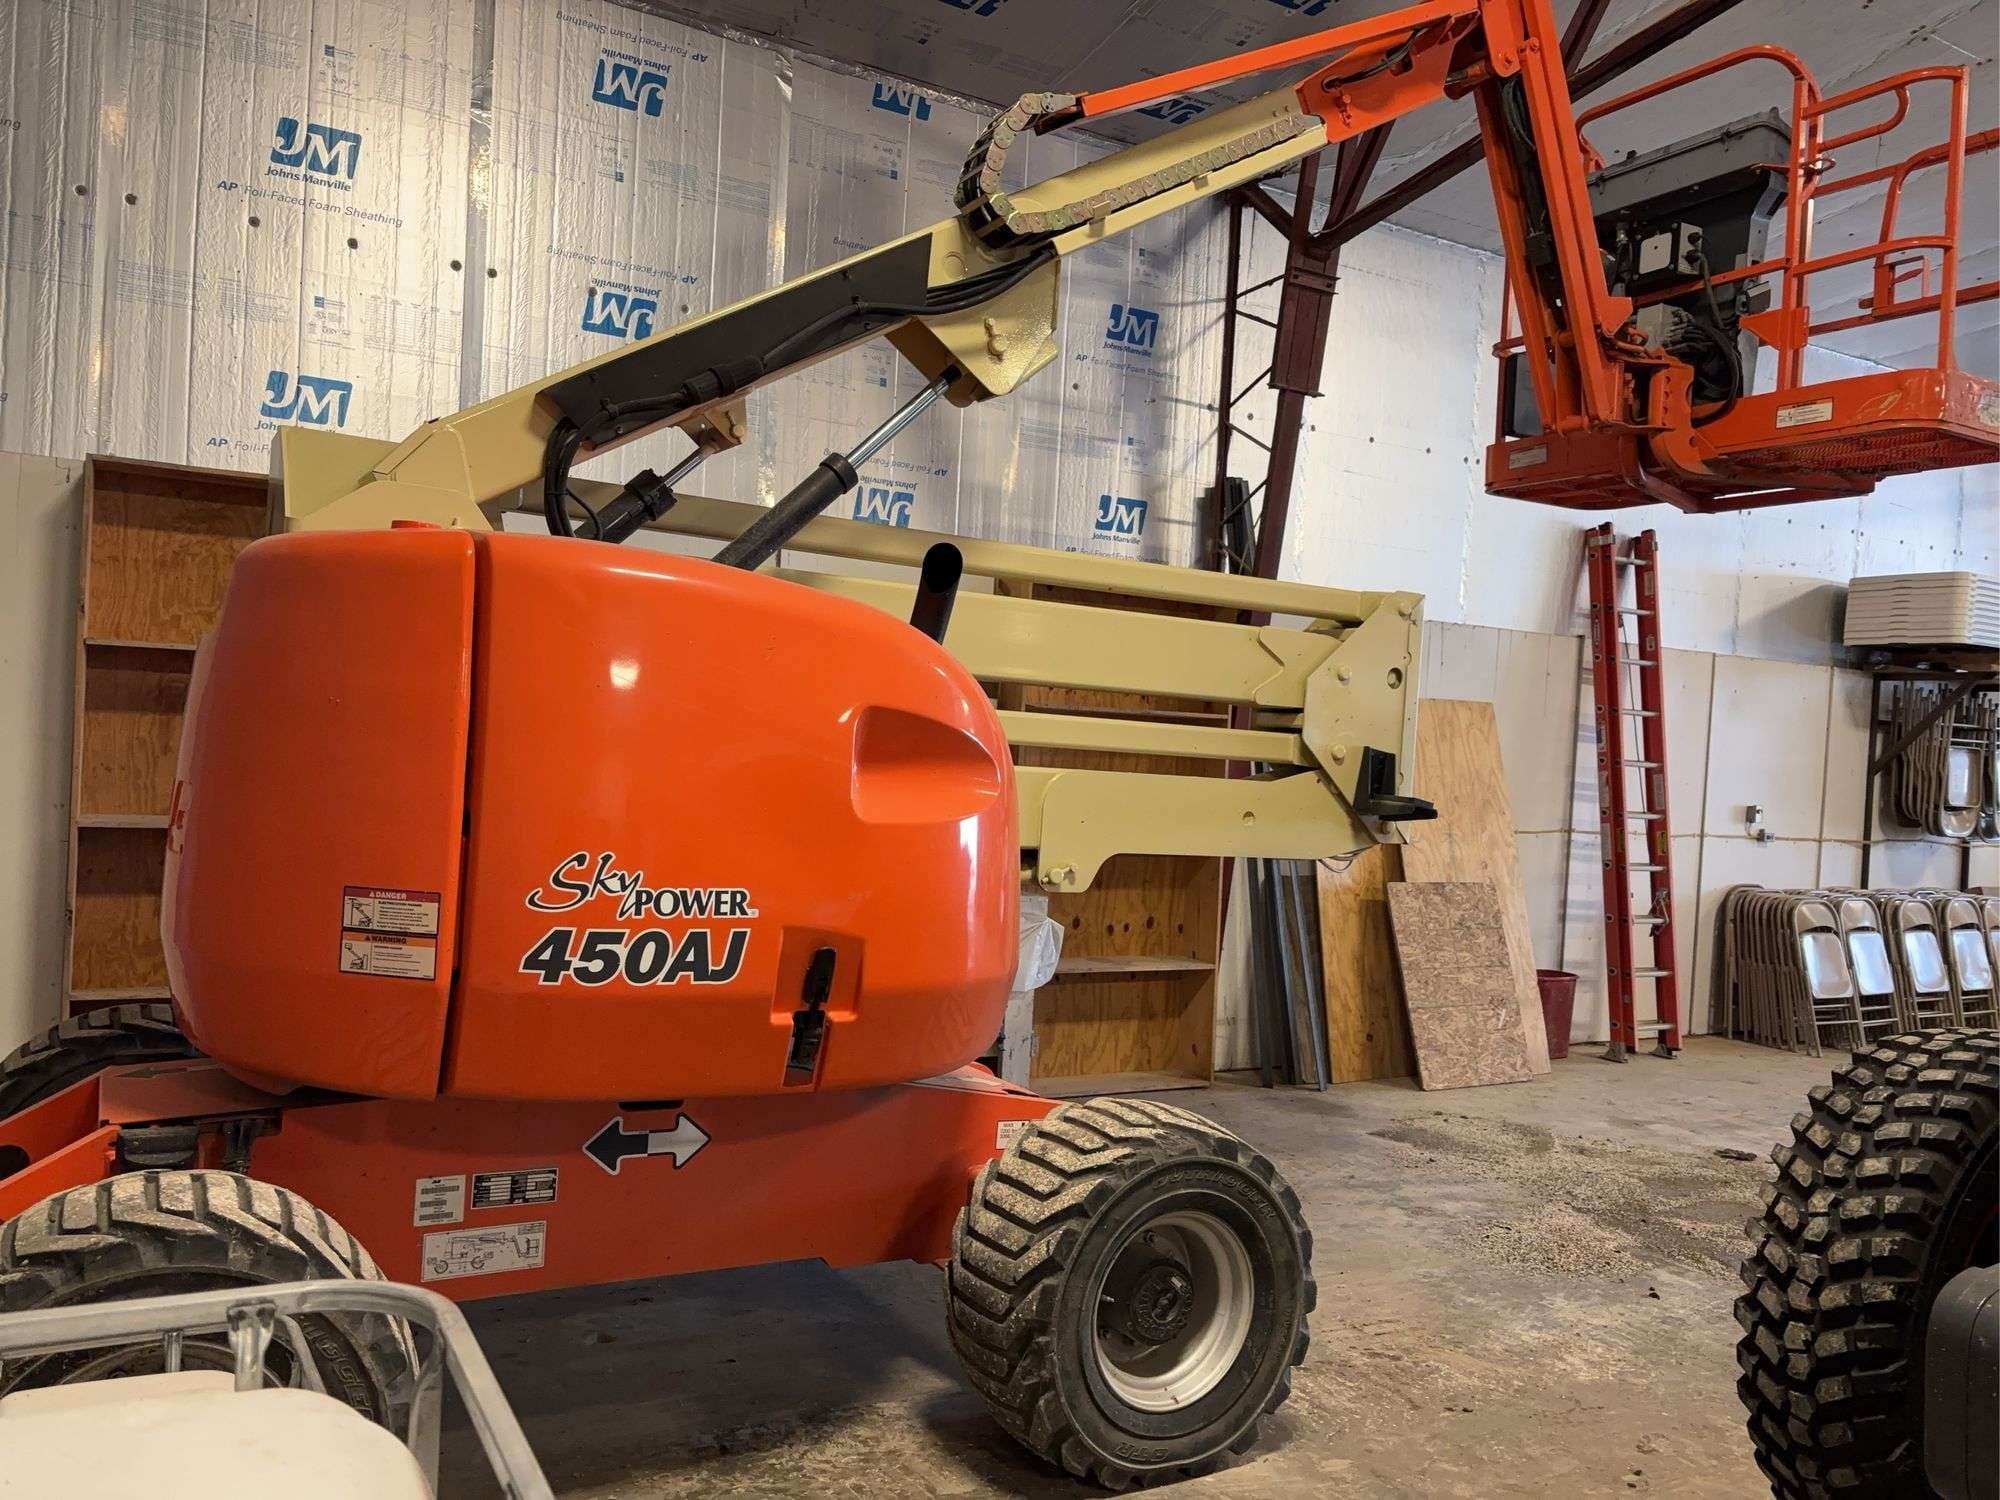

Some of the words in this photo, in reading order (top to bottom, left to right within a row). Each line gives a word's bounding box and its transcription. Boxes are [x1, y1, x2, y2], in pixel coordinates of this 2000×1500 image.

[609, 28, 638, 43] Foam
[601, 48, 644, 66] Manville
[643, 60, 672, 74] Johns
[591, 58, 668, 118] JM
[270, 116, 363, 180] JM
[264, 165, 301, 182] Johns
[301, 173, 352, 192] Manville
[217, 180, 239, 191] AP
[244, 185, 305, 206] Foil-Faced
[308, 198, 341, 214] Foam
[344, 206, 404, 228] Sheathing
[591, 277, 633, 293] Manville
[633, 286, 662, 299] Johns
[581, 287, 658, 341] JM
[1105, 303, 1160, 348] JM
[260, 370, 353, 428] JM
[206, 437, 228, 448] AP
[894, 480, 918, 491] Johns
[852, 484, 914, 529] JM
[1094, 494, 1149, 536] JM
[375, 890, 407, 901] DANGER
[371, 935, 407, 945] WARNING
[519, 927, 751, 986] 450AJ
